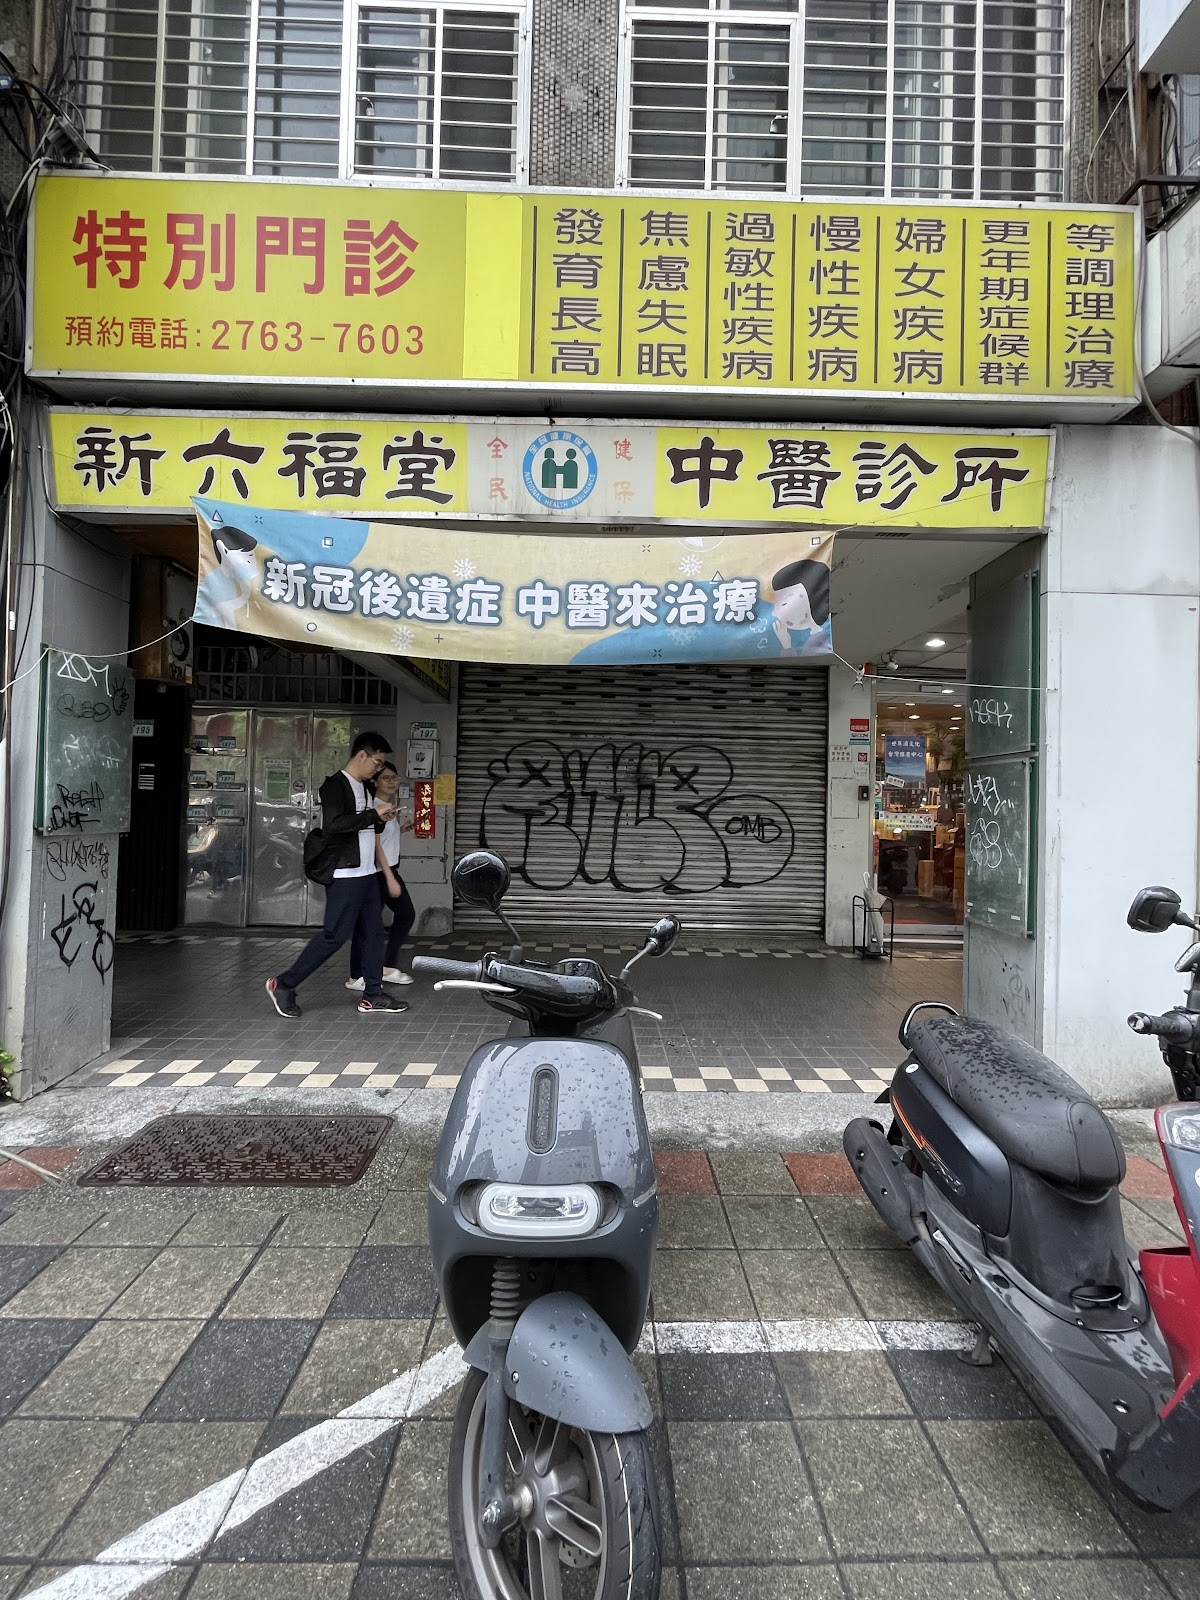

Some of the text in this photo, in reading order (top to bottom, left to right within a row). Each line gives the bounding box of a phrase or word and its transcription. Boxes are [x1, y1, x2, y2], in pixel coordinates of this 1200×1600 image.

[73, 209, 419, 298] 特別門診
[549, 207, 604, 378] 發育長高
[636, 209, 690, 380] 焦慮失眠
[721, 211, 775, 382] 過敏性疾病
[807, 214, 862, 384] 慢性疾病
[892, 216, 947, 386] 婦女疾病
[978, 220, 1031, 388] 更年期症候群
[1063, 222, 1116, 390] 等調理治療
[73, 426, 457, 504] 新六福堂
[524, 471, 596, 508] NATIONAL HEALTH INSURANCE
[665, 436, 1030, 511] 中醫診所
[264, 557, 759, 628] 新冠後遺症 中醫來治療
[135, 726, 151, 734] 195
[420, 730, 435, 738] 197
